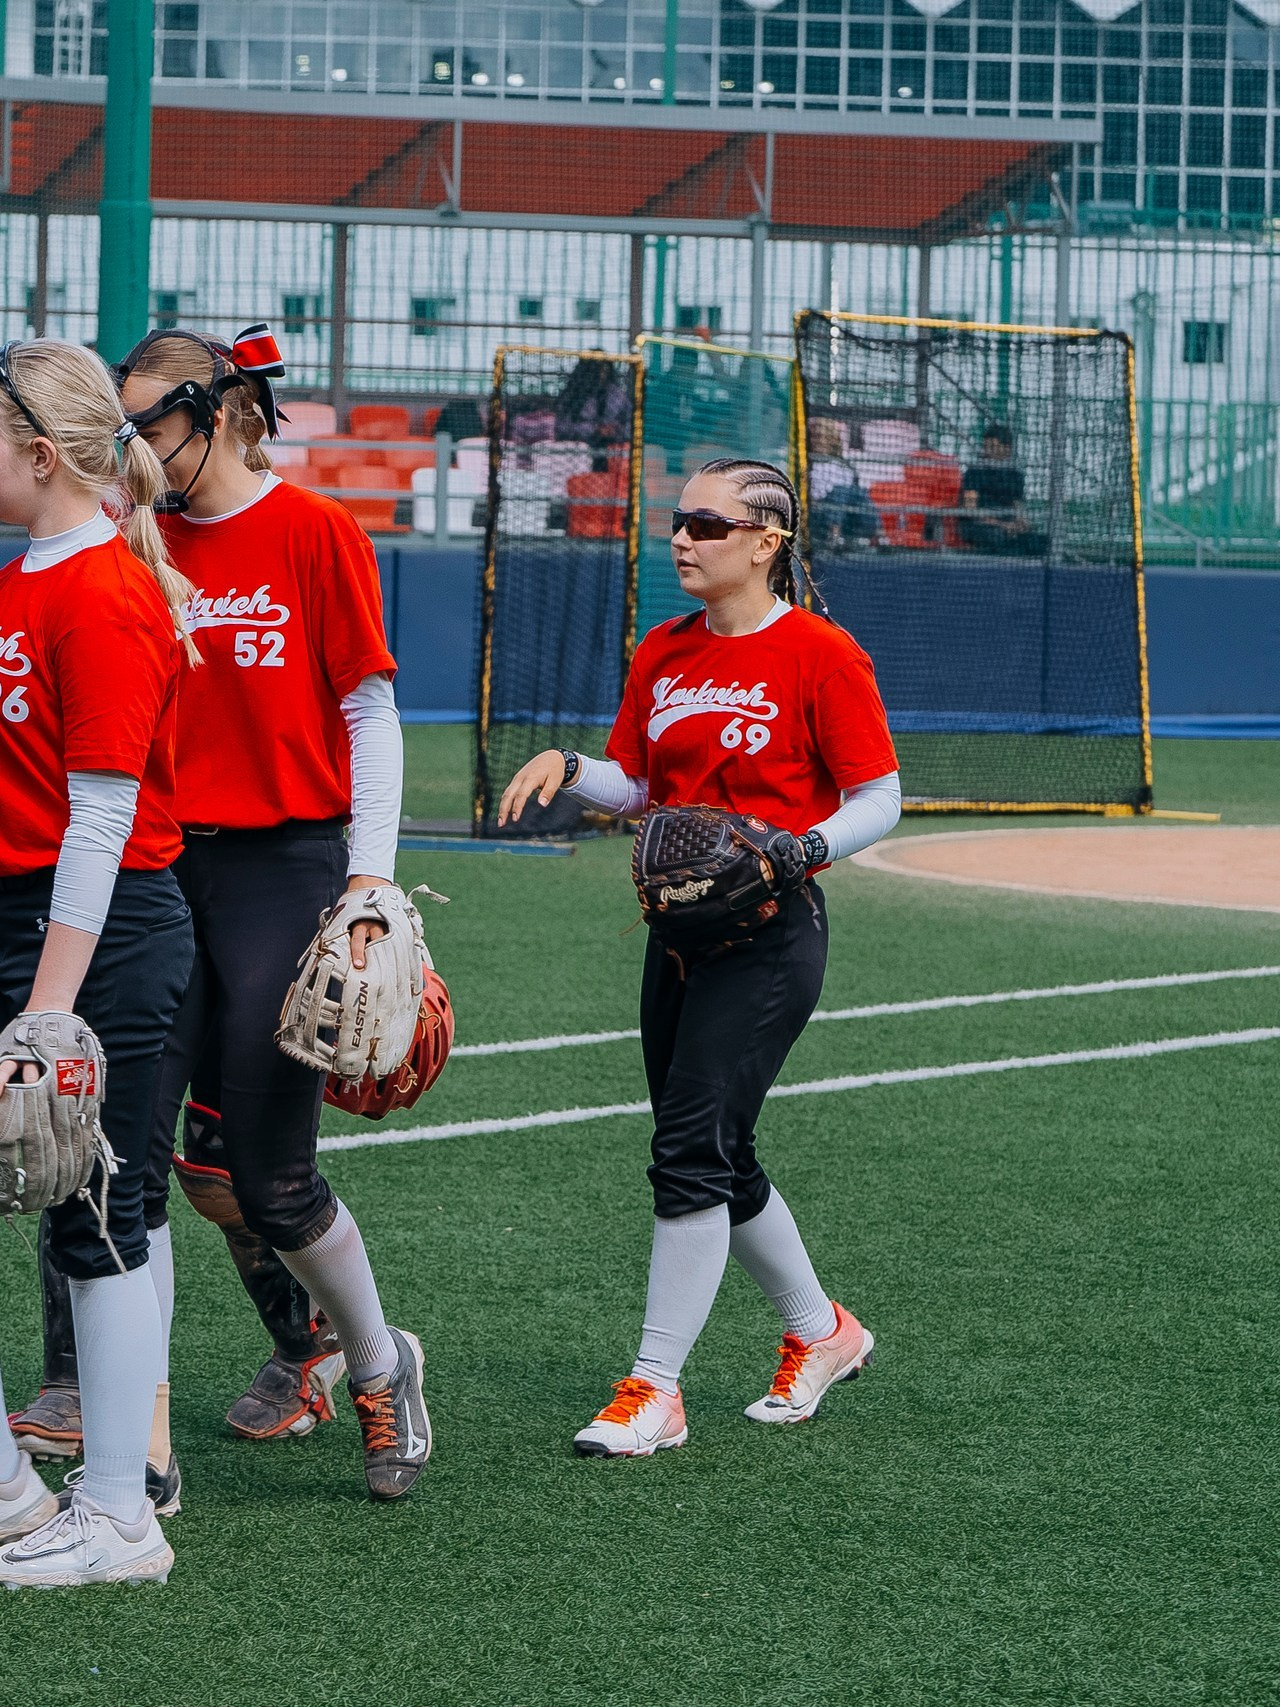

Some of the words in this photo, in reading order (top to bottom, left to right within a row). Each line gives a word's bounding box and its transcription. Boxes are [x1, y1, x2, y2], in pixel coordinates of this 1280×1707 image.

[234, 631, 286, 667] 52
[720, 717, 771, 756] 69
[660, 878, 715, 903] Rawlings
[351, 980, 369, 1048] EASTON
